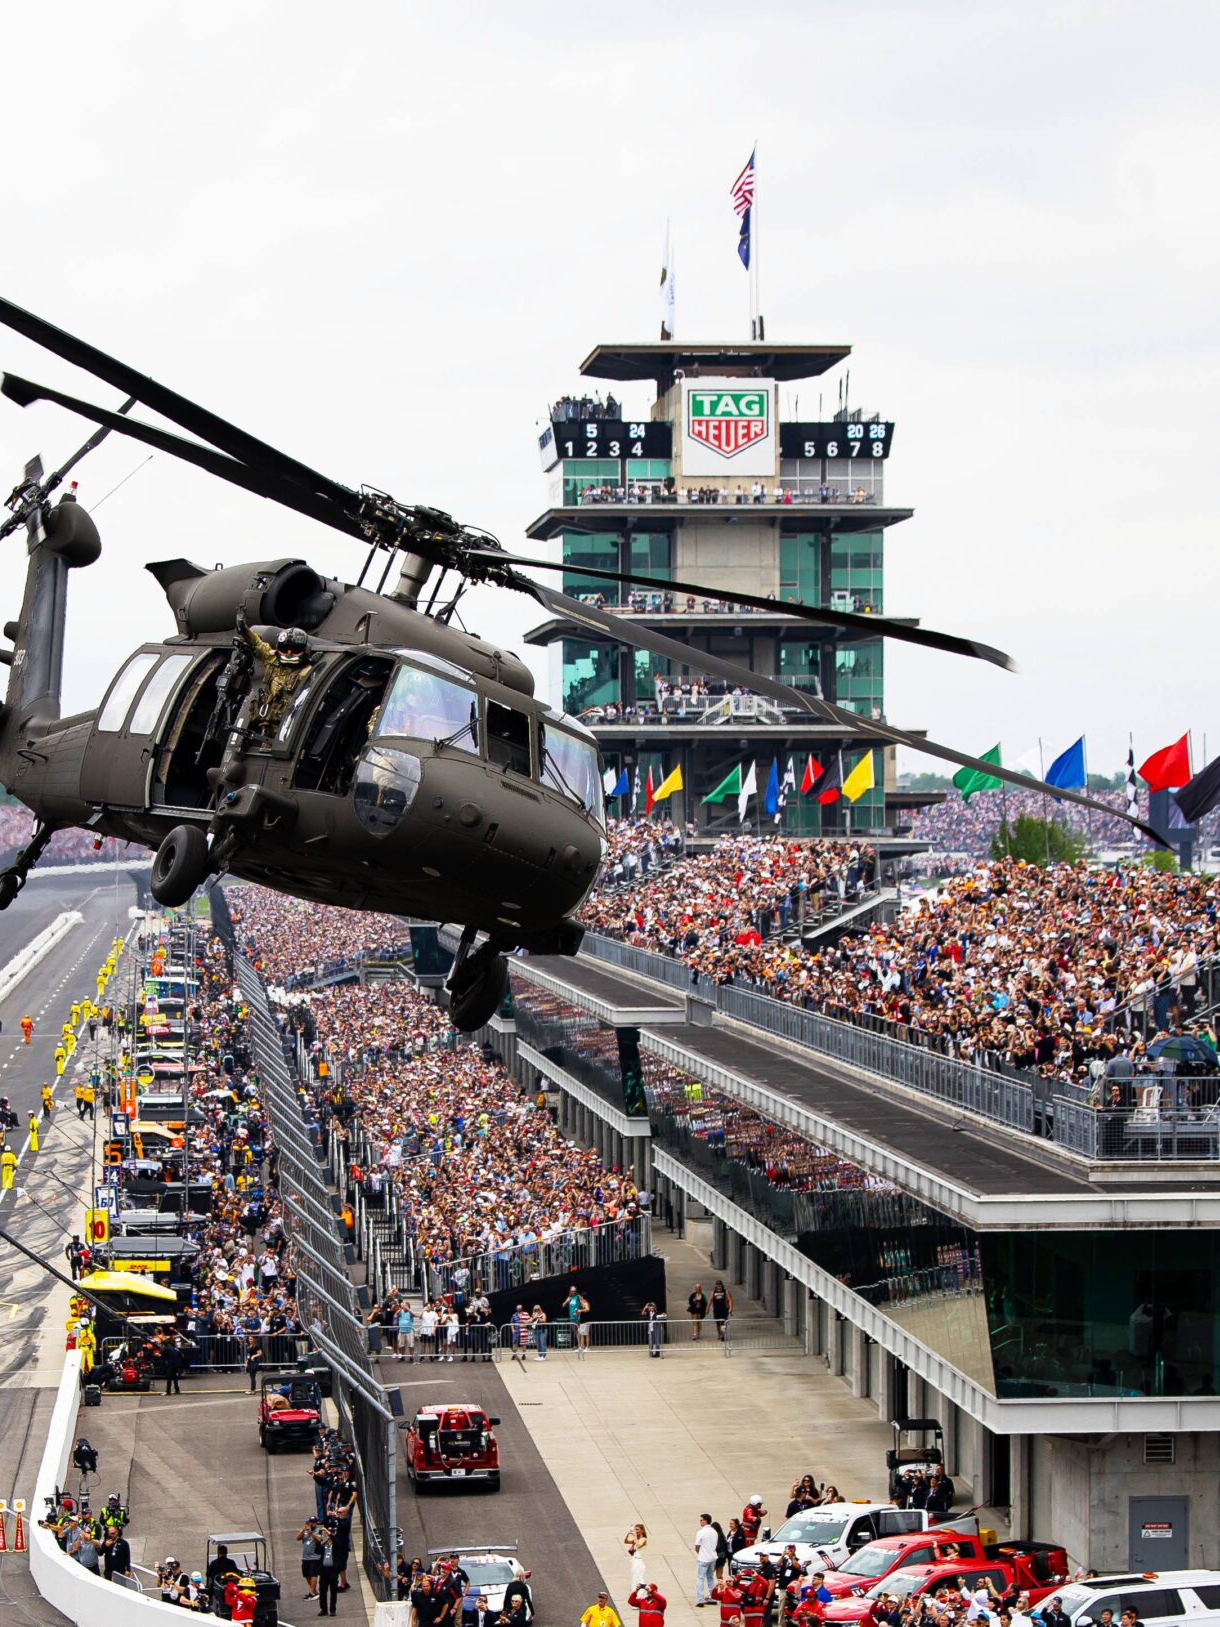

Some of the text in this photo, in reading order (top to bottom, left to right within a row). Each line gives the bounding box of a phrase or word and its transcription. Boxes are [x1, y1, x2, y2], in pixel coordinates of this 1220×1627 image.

[696, 395, 760, 415] TAG
[586, 424, 646, 438] 5 24
[694, 421, 762, 452] HEUER
[847, 424, 886, 438] 20 26
[565, 441, 643, 456] 1 2 3 4
[804, 442, 883, 457] 5 6 7 8
[89, 1220, 105, 1239] 10
